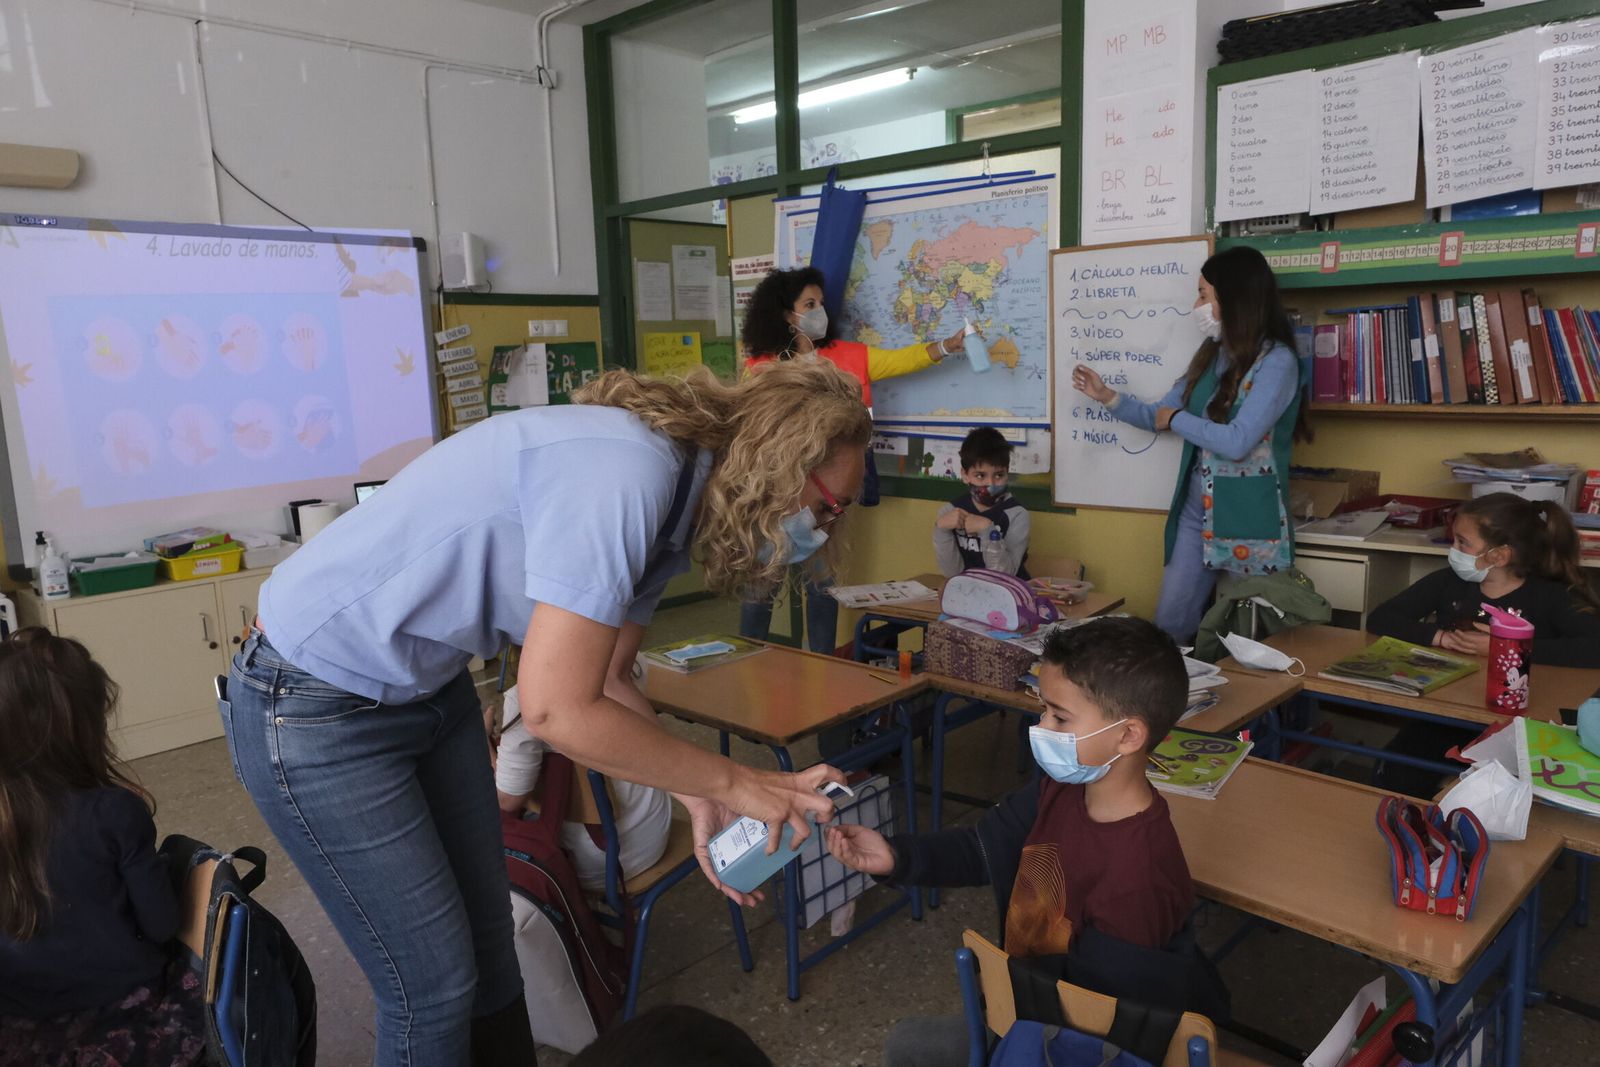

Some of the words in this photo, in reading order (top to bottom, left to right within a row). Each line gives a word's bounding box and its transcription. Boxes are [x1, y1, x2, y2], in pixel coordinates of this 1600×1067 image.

[1106, 35, 1127, 56] MP
[1144, 25, 1167, 47] MB
[1552, 32, 1568, 44] 30
[1432, 62, 1444, 73] 20
[1553, 62, 1567, 73] 32
[1322, 78, 1333, 86] 10
[1435, 76, 1446, 85] 21
[1552, 77, 1566, 88] 33
[1232, 91, 1237, 100] 0
[1434, 89, 1446, 100] 22
[1552, 92, 1565, 102] 34
[1234, 104, 1237, 112] 1
[1322, 103, 1332, 112] 12
[1434, 103, 1447, 113] 23
[1551, 105, 1565, 117] 35
[1106, 110, 1125, 122] He
[1232, 116, 1237, 124] 2
[1323, 116, 1332, 125] 13
[1435, 117, 1448, 127] 24
[1549, 121, 1563, 132] 36
[1105, 134, 1125, 147] Ha
[1153, 128, 1174, 139] ado
[1322, 130, 1332, 138] 14
[1436, 130, 1448, 140] 25
[1549, 135, 1562, 146] 37
[1322, 142, 1332, 151] 15
[1436, 143, 1448, 154] 26
[1322, 155, 1331, 163] 16
[1547, 149, 1562, 160] 38
[1437, 157, 1449, 167] 27
[1321, 168, 1331, 176] 17
[1547, 163, 1561, 174] 39
[1101, 169, 1126, 192] BR
[1144, 165, 1173, 187] BL
[1230, 176, 1235, 184] 7
[1438, 170, 1450, 181] 28
[1320, 180, 1330, 189] 18
[1438, 183, 1450, 194] 29
[991, 189, 1023, 198] Planisferio
[1025, 185, 1048, 194] político
[1229, 188, 1235, 196] 8
[1320, 193, 1330, 201] 19
[1229, 200, 1234, 208] 9
[146, 236, 161, 256] 4.
[170, 237, 231, 256] Lavado
[239, 238, 258, 257] de
[265, 243, 318, 258] manos.
[1325, 253, 1334, 261] 10
[1551, 238, 1562, 246] 28
[1565, 237, 1576, 245] 29
[1070, 269, 1079, 282] 1.
[1081, 265, 1134, 280] CÁLCULO
[1140, 262, 1189, 275] MENTAL
[1086, 286, 1136, 298] LIBRETA
[1084, 325, 1123, 339] VÍDEO
[1086, 348, 1120, 362] SÚPER
[1125, 352, 1163, 366] PODER
[1102, 368, 1128, 384] GLÉS
[1084, 429, 1118, 445] MÚSICA
